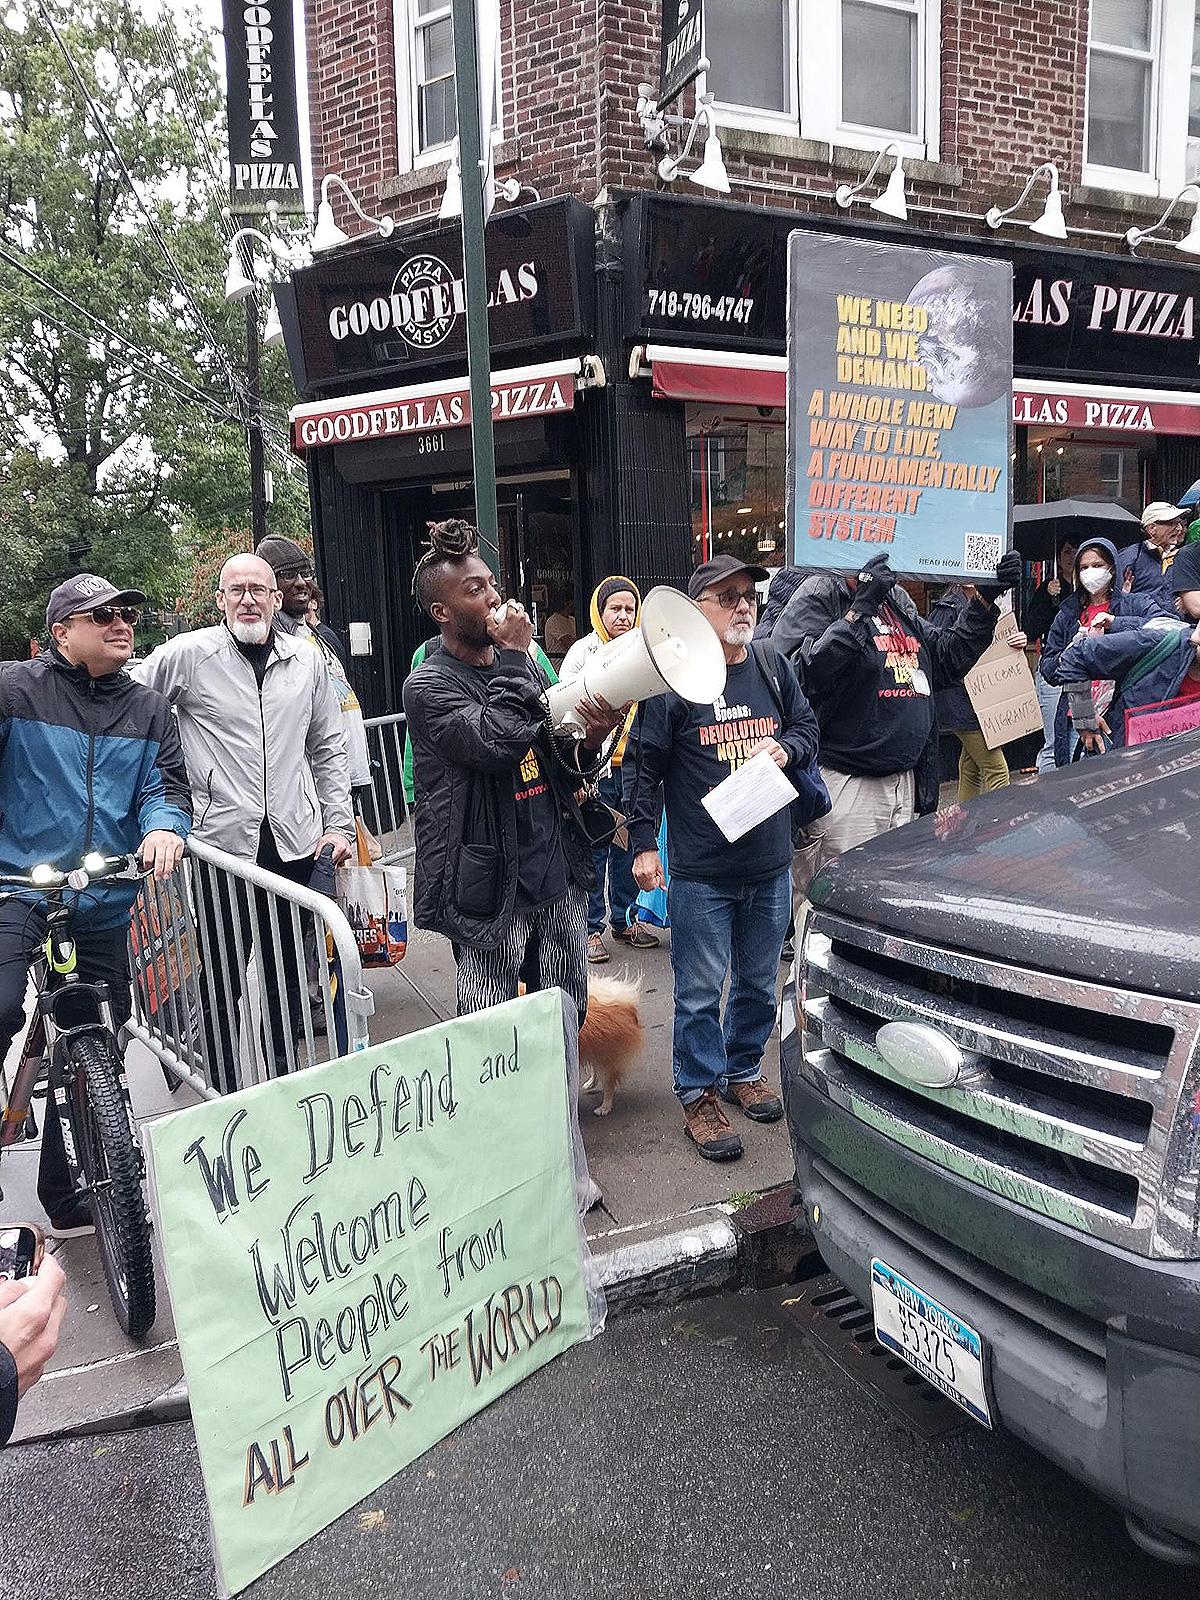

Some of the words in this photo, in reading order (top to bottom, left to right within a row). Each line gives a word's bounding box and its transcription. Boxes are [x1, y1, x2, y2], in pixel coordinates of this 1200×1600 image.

[234, 163, 299, 190] PIZZA
[401, 260, 442, 288] PIZZA
[648, 289, 754, 324] 718-796-4747
[836, 294, 872, 326] WE
[875, 300, 929, 334] NEED
[1086, 284, 1195, 340] PIZZA
[405, 317, 450, 344] PASTA
[836, 326, 882, 357] AND
[886, 331, 920, 361] WE
[301, 396, 464, 446] GOODFELLAS
[807, 389, 825, 418] A
[829, 391, 905, 425] WHOLE
[907, 401, 958, 430] NEW
[1084, 401, 1155, 431] PIZZA
[418, 433, 446, 455] 3661
[809, 419, 859, 449] WAY
[863, 426, 891, 453] TO
[893, 430, 943, 460] LIVE,
[807, 449, 825, 478] A
[828, 452, 1001, 493] FUNDAMENTALLY
[808, 480, 923, 514] DIFFERENT
[808, 511, 897, 544] SYSTEM
[919, 558, 940, 566] READ
[966, 662, 1023, 697] WELCOME
[982, 699, 1038, 740] MIGRANTS
[184, 1109, 271, 1225] We
[297, 1038, 459, 1184] Defend
[479, 1026, 521, 1085] and
[248, 1177, 431, 1324] Welcome
[276, 1273, 409, 1401] People
[437, 1219, 508, 1297] from
[895, 1280, 921, 1314] NEW
[924, 1301, 955, 1341] YORK
[907, 1309, 956, 1382] 5325
[243, 1424, 309, 1508] ALL
[324, 1355, 412, 1448] OVER
[420, 1328, 461, 1381] THE
[465, 1275, 562, 1387] WORLD
[941, 1380, 961, 1401] STATE
